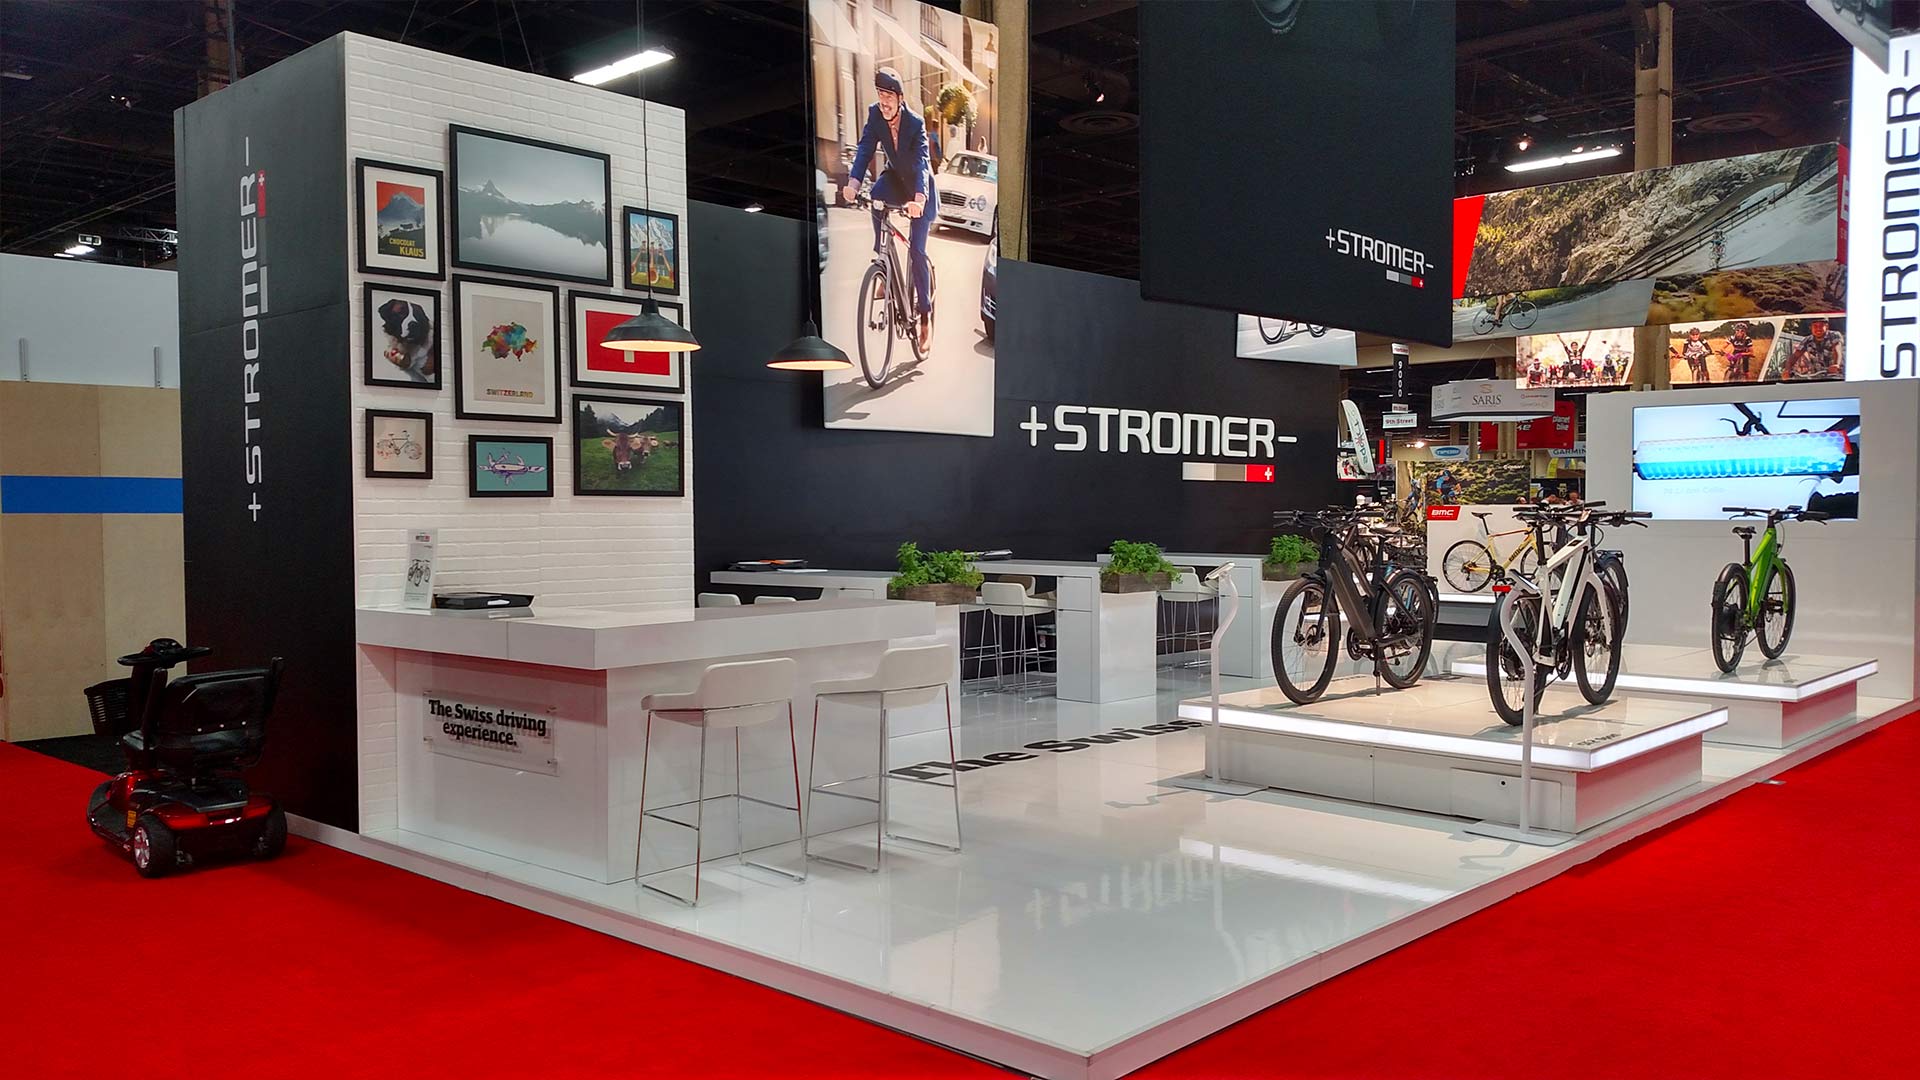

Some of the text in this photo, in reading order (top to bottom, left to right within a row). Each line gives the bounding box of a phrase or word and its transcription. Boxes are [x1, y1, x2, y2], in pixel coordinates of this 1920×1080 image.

[400, 246, 424, 257] KLAUS
[486, 388, 534, 398] SWITZERLAND
[1472, 395, 1502, 406] SARIS
[428, 699, 546, 736] The Swiss driving
[443, 721, 518, 745] experience.
